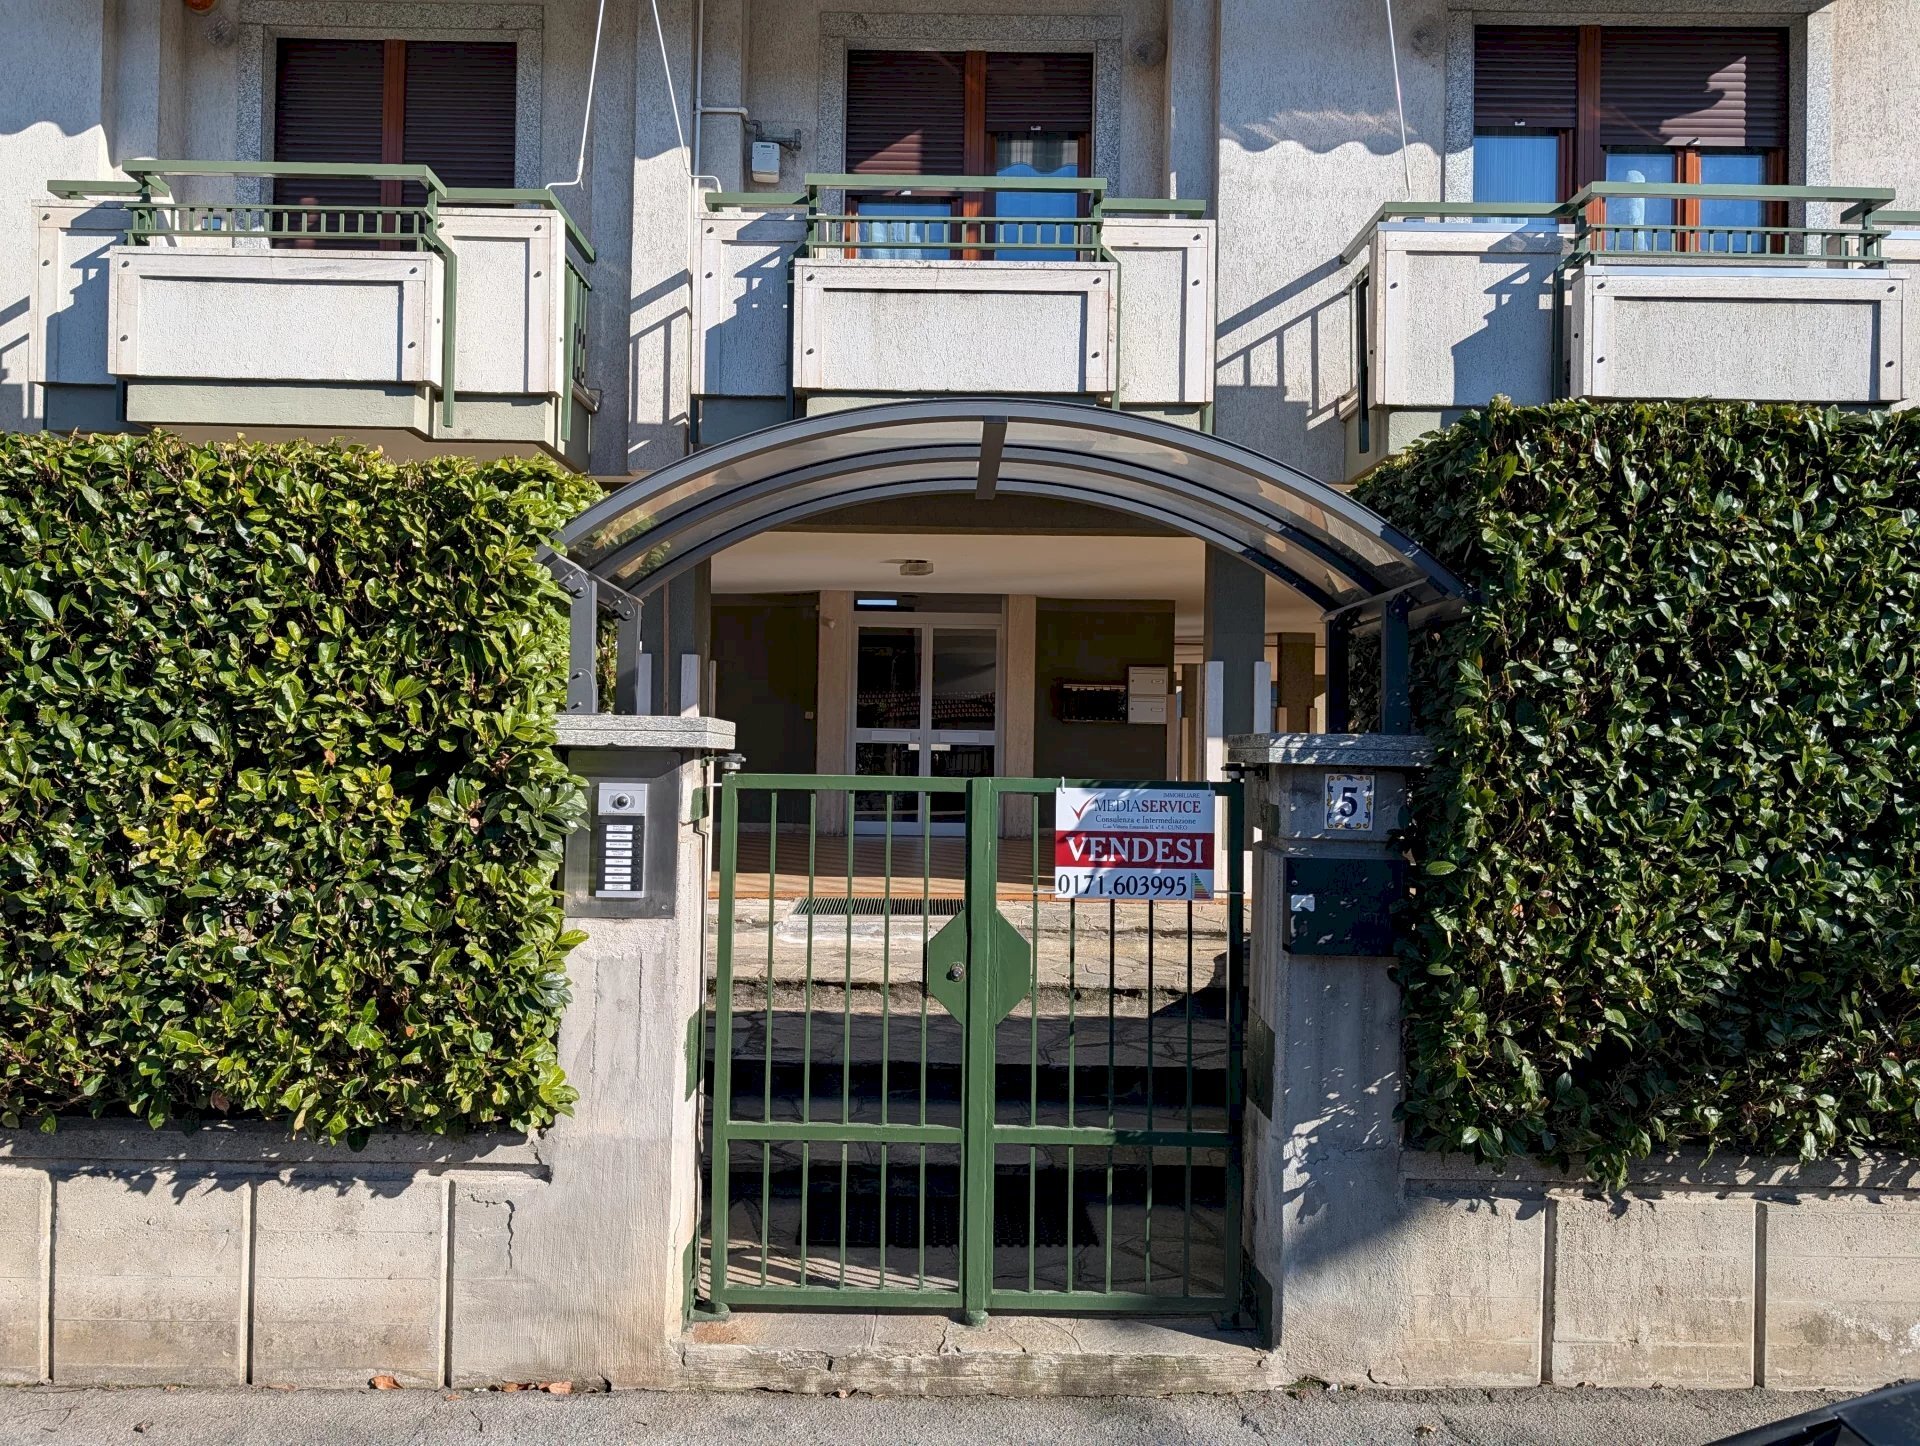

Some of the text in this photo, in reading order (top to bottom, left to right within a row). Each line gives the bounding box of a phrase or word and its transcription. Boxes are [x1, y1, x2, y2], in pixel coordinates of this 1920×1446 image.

[1094, 799, 1201, 813] MEDIASERVICE
[1339, 787, 1358, 817] 5
[1095, 815, 1134, 823] Consulenza
[1142, 816, 1196, 825] Intermediazione
[1066, 837, 1203, 863] VENDESI
[1058, 874, 1187, 896] 0171.603995
